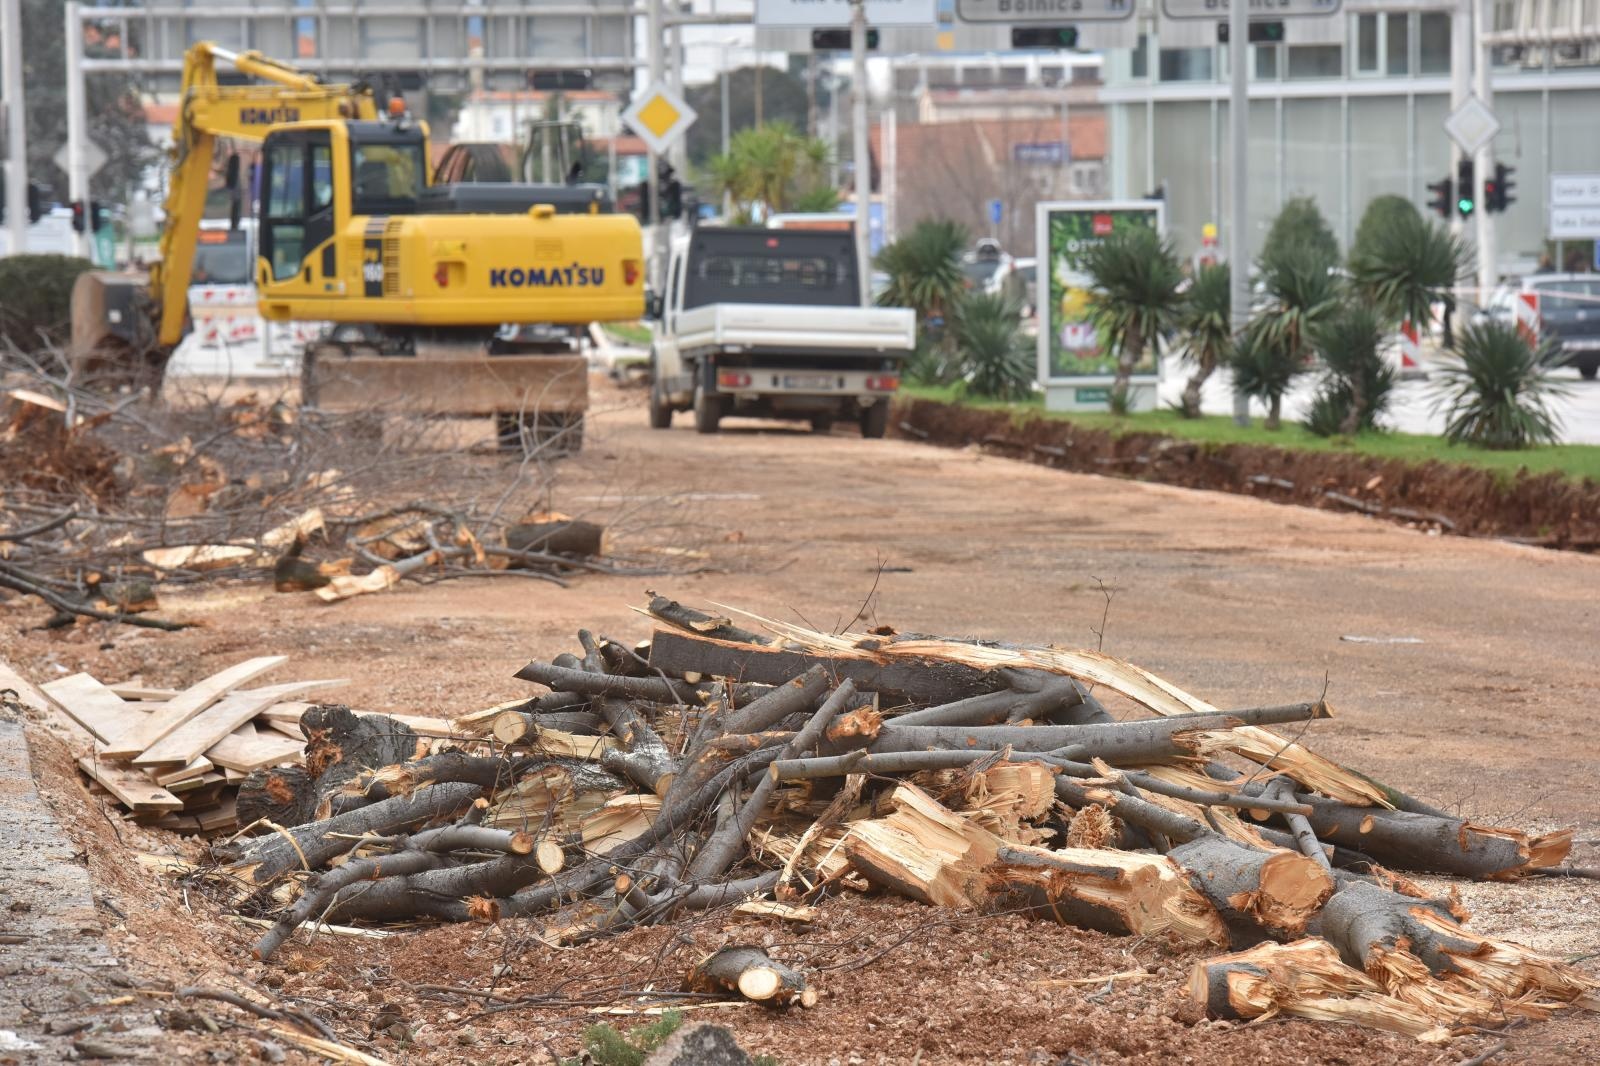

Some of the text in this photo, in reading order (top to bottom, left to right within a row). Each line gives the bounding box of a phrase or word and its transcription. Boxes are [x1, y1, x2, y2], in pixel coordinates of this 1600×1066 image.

[1204, 0, 1290, 10] Boica
[240, 106, 299, 125] KOMATSU
[490, 261, 604, 287] KOMATSU
